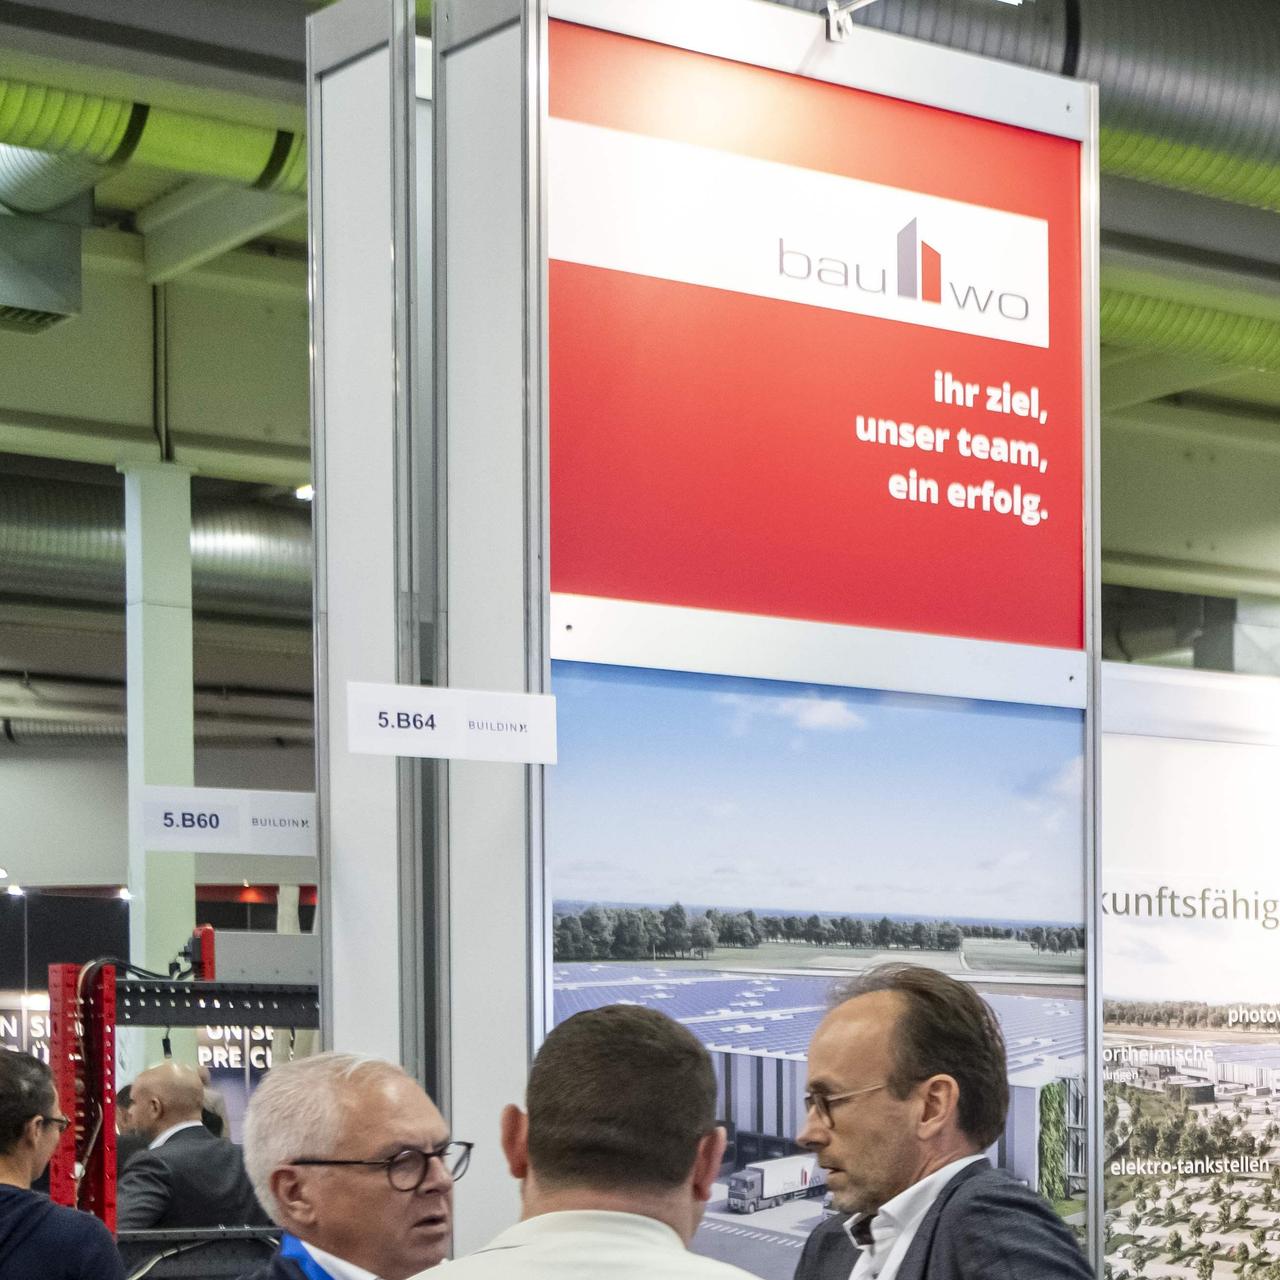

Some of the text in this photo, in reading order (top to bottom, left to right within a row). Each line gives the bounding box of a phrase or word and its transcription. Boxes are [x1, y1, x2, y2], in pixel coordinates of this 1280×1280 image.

[934, 369, 1048, 425] ihr ziel,
[856, 415, 1048, 474] unser team,
[888, 468, 1049, 526] ein erfolg.
[378, 711, 435, 731] 5.B64
[163, 812, 220, 829] 5.B60
[1110, 1155, 1270, 1176] elektro-tankstellen
